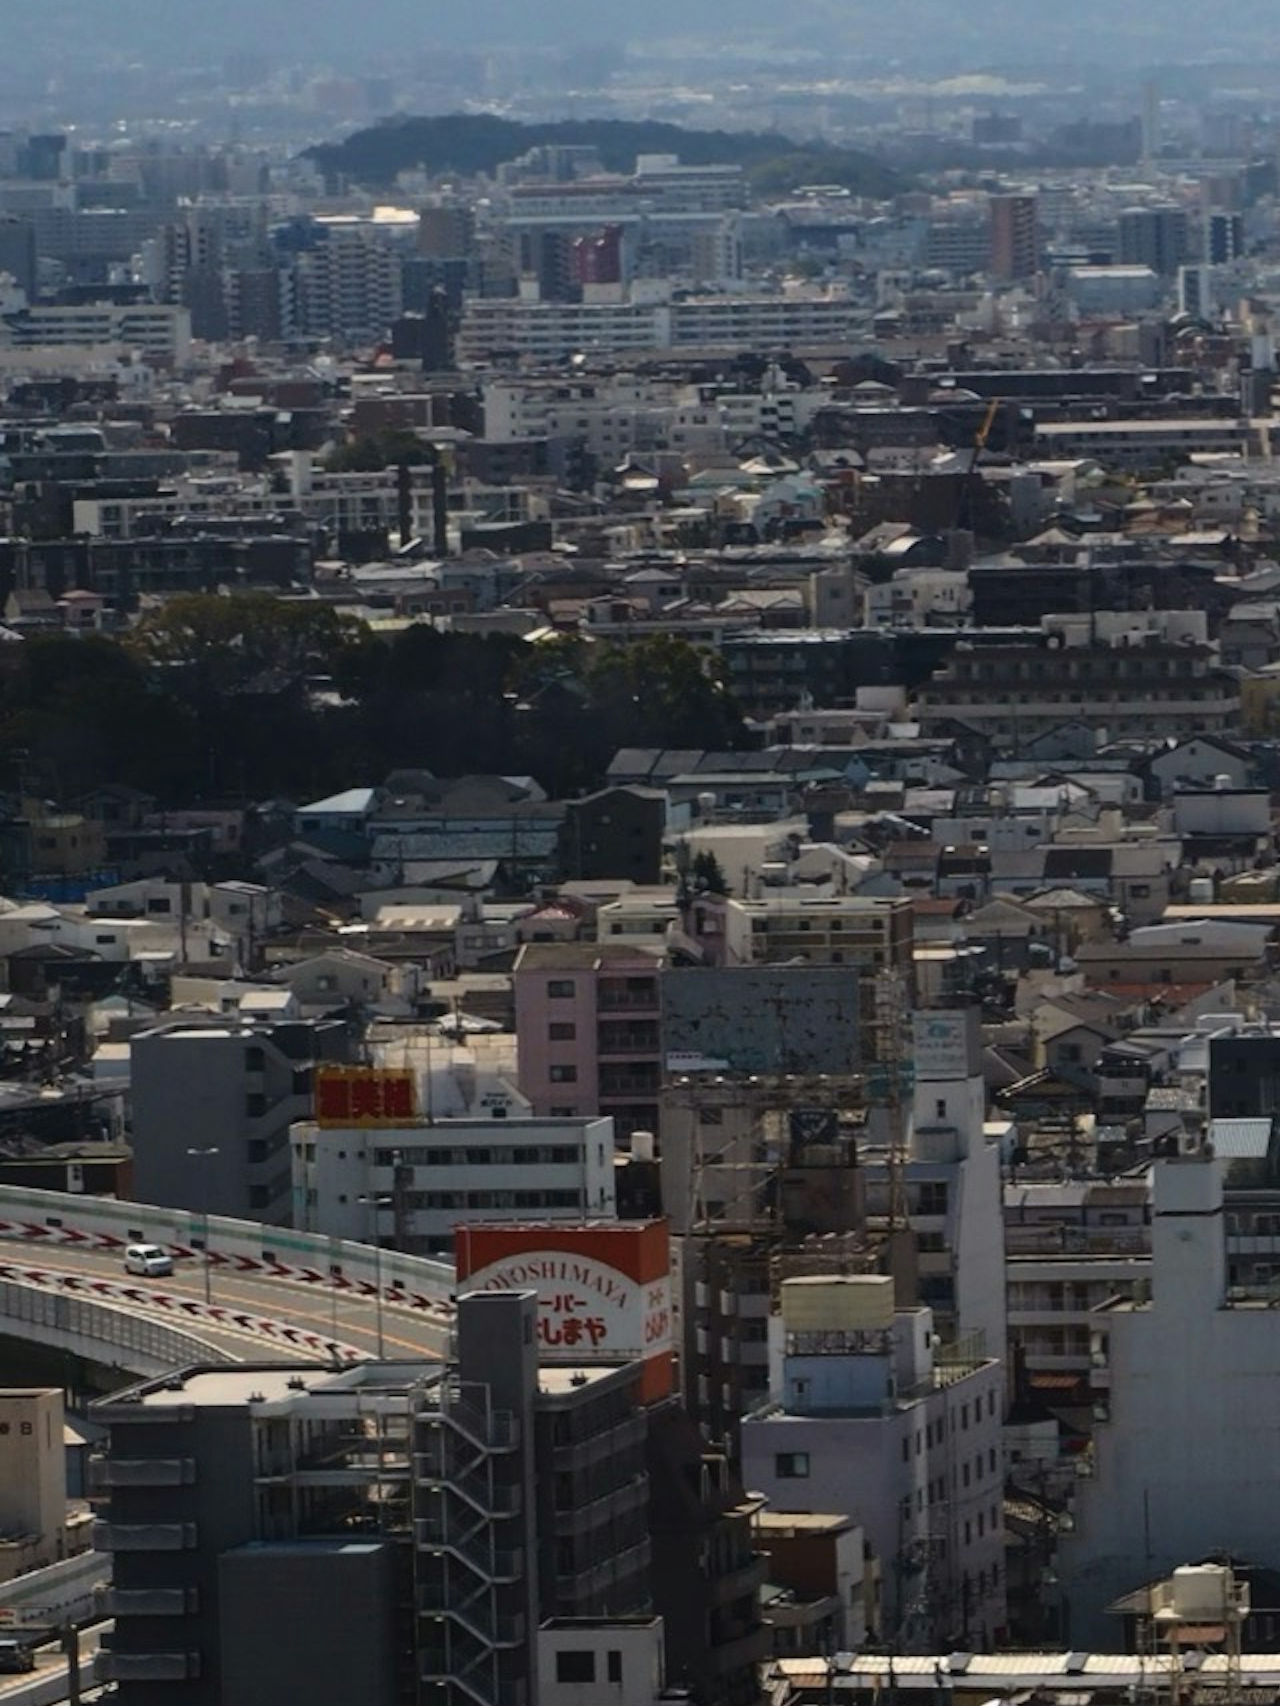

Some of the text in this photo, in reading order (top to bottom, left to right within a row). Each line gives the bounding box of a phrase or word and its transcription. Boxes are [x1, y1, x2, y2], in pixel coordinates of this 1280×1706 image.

[476, 1260, 628, 1310] OYOSHIMAYA
[539, 1294, 587, 1313] ーパー
[537, 1317, 607, 1346] しまや
